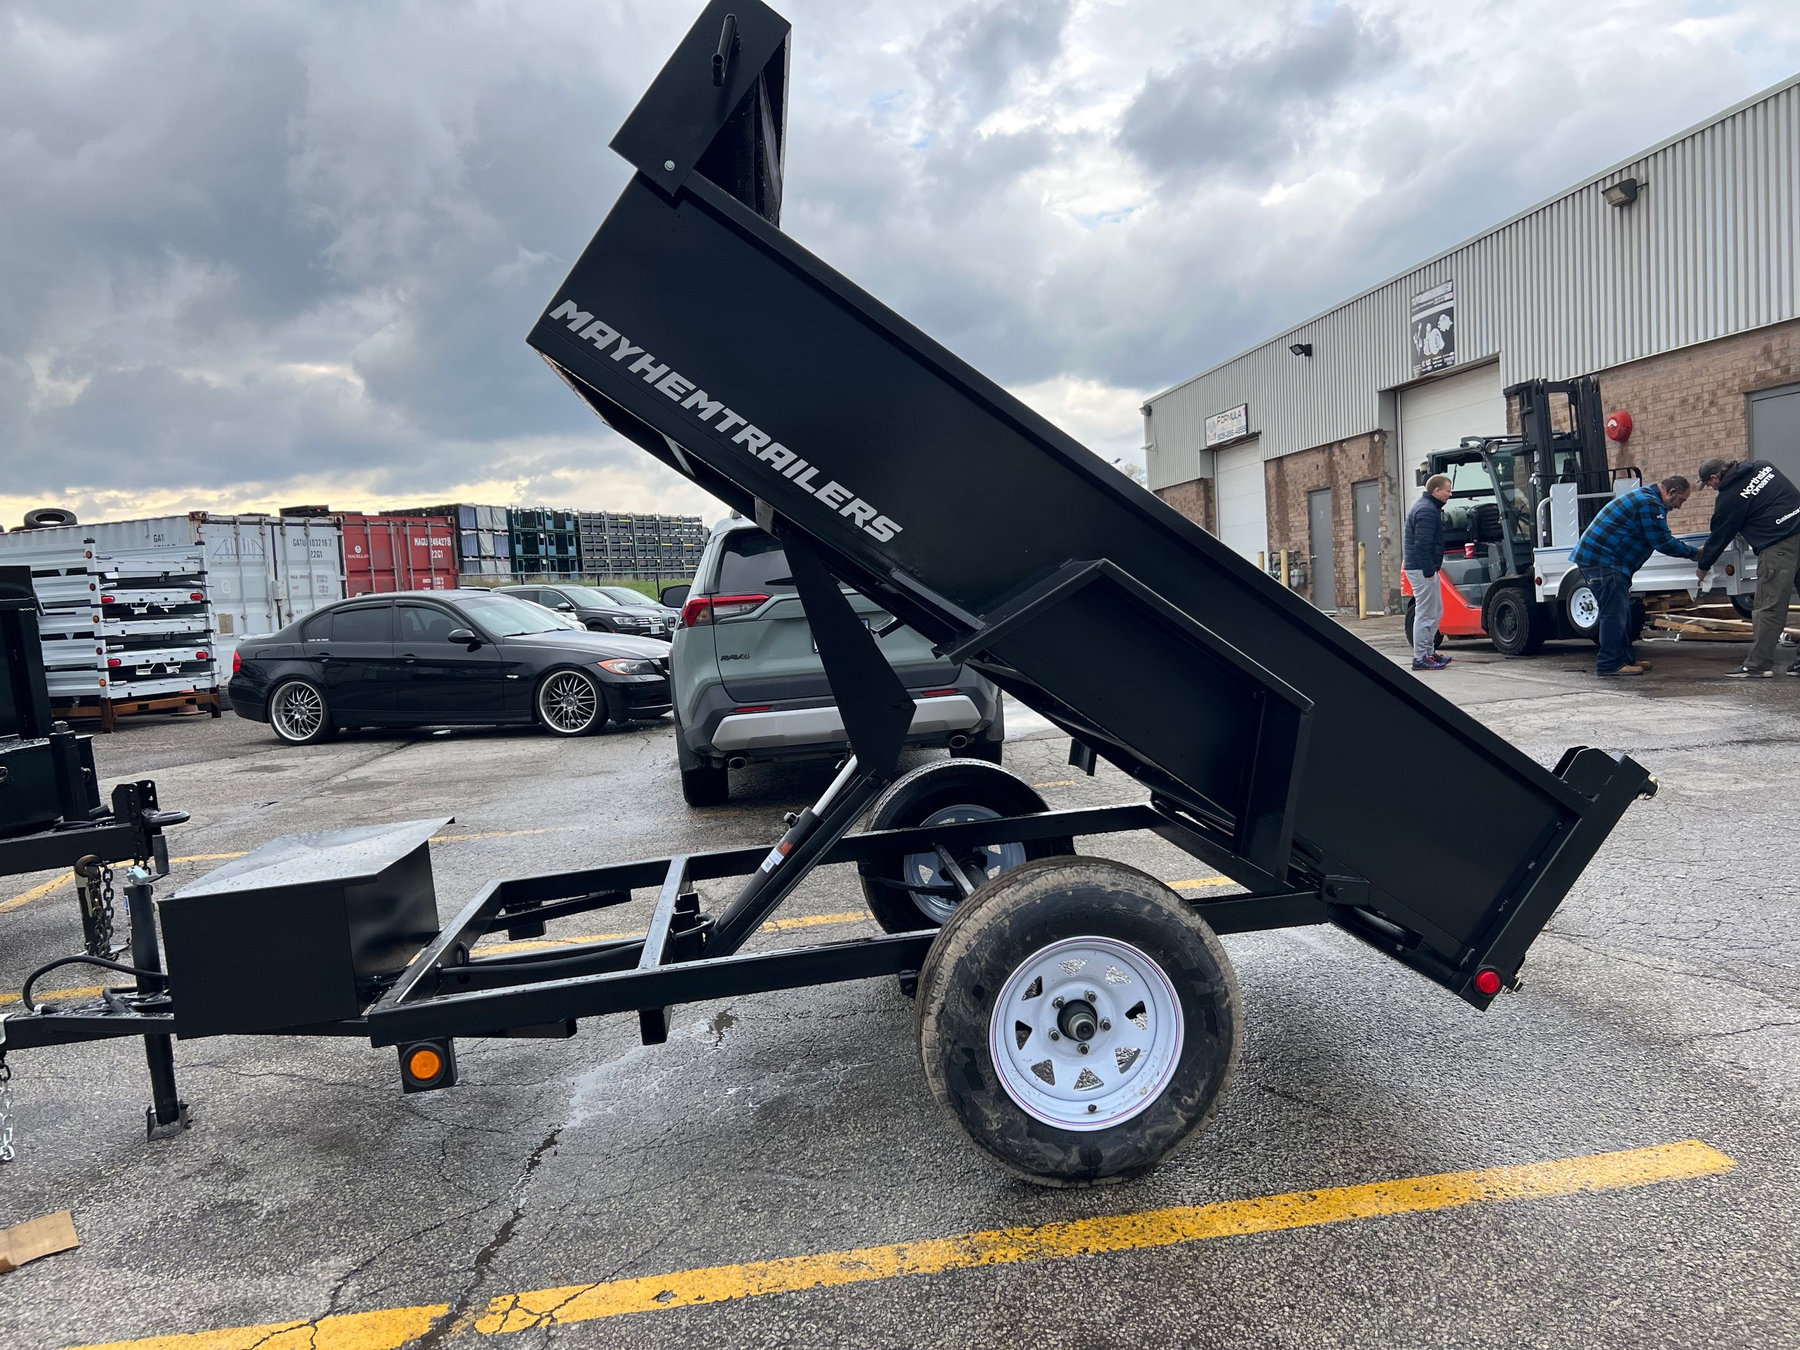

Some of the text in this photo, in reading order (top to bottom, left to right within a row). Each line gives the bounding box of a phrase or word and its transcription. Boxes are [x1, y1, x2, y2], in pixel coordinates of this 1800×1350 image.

[548, 299, 903, 543] MAYHEMTRAILERS
[1740, 466, 1772, 498] Northside
[1751, 473, 1775, 495] Dreams
[720, 653, 750, 661] RAV4
